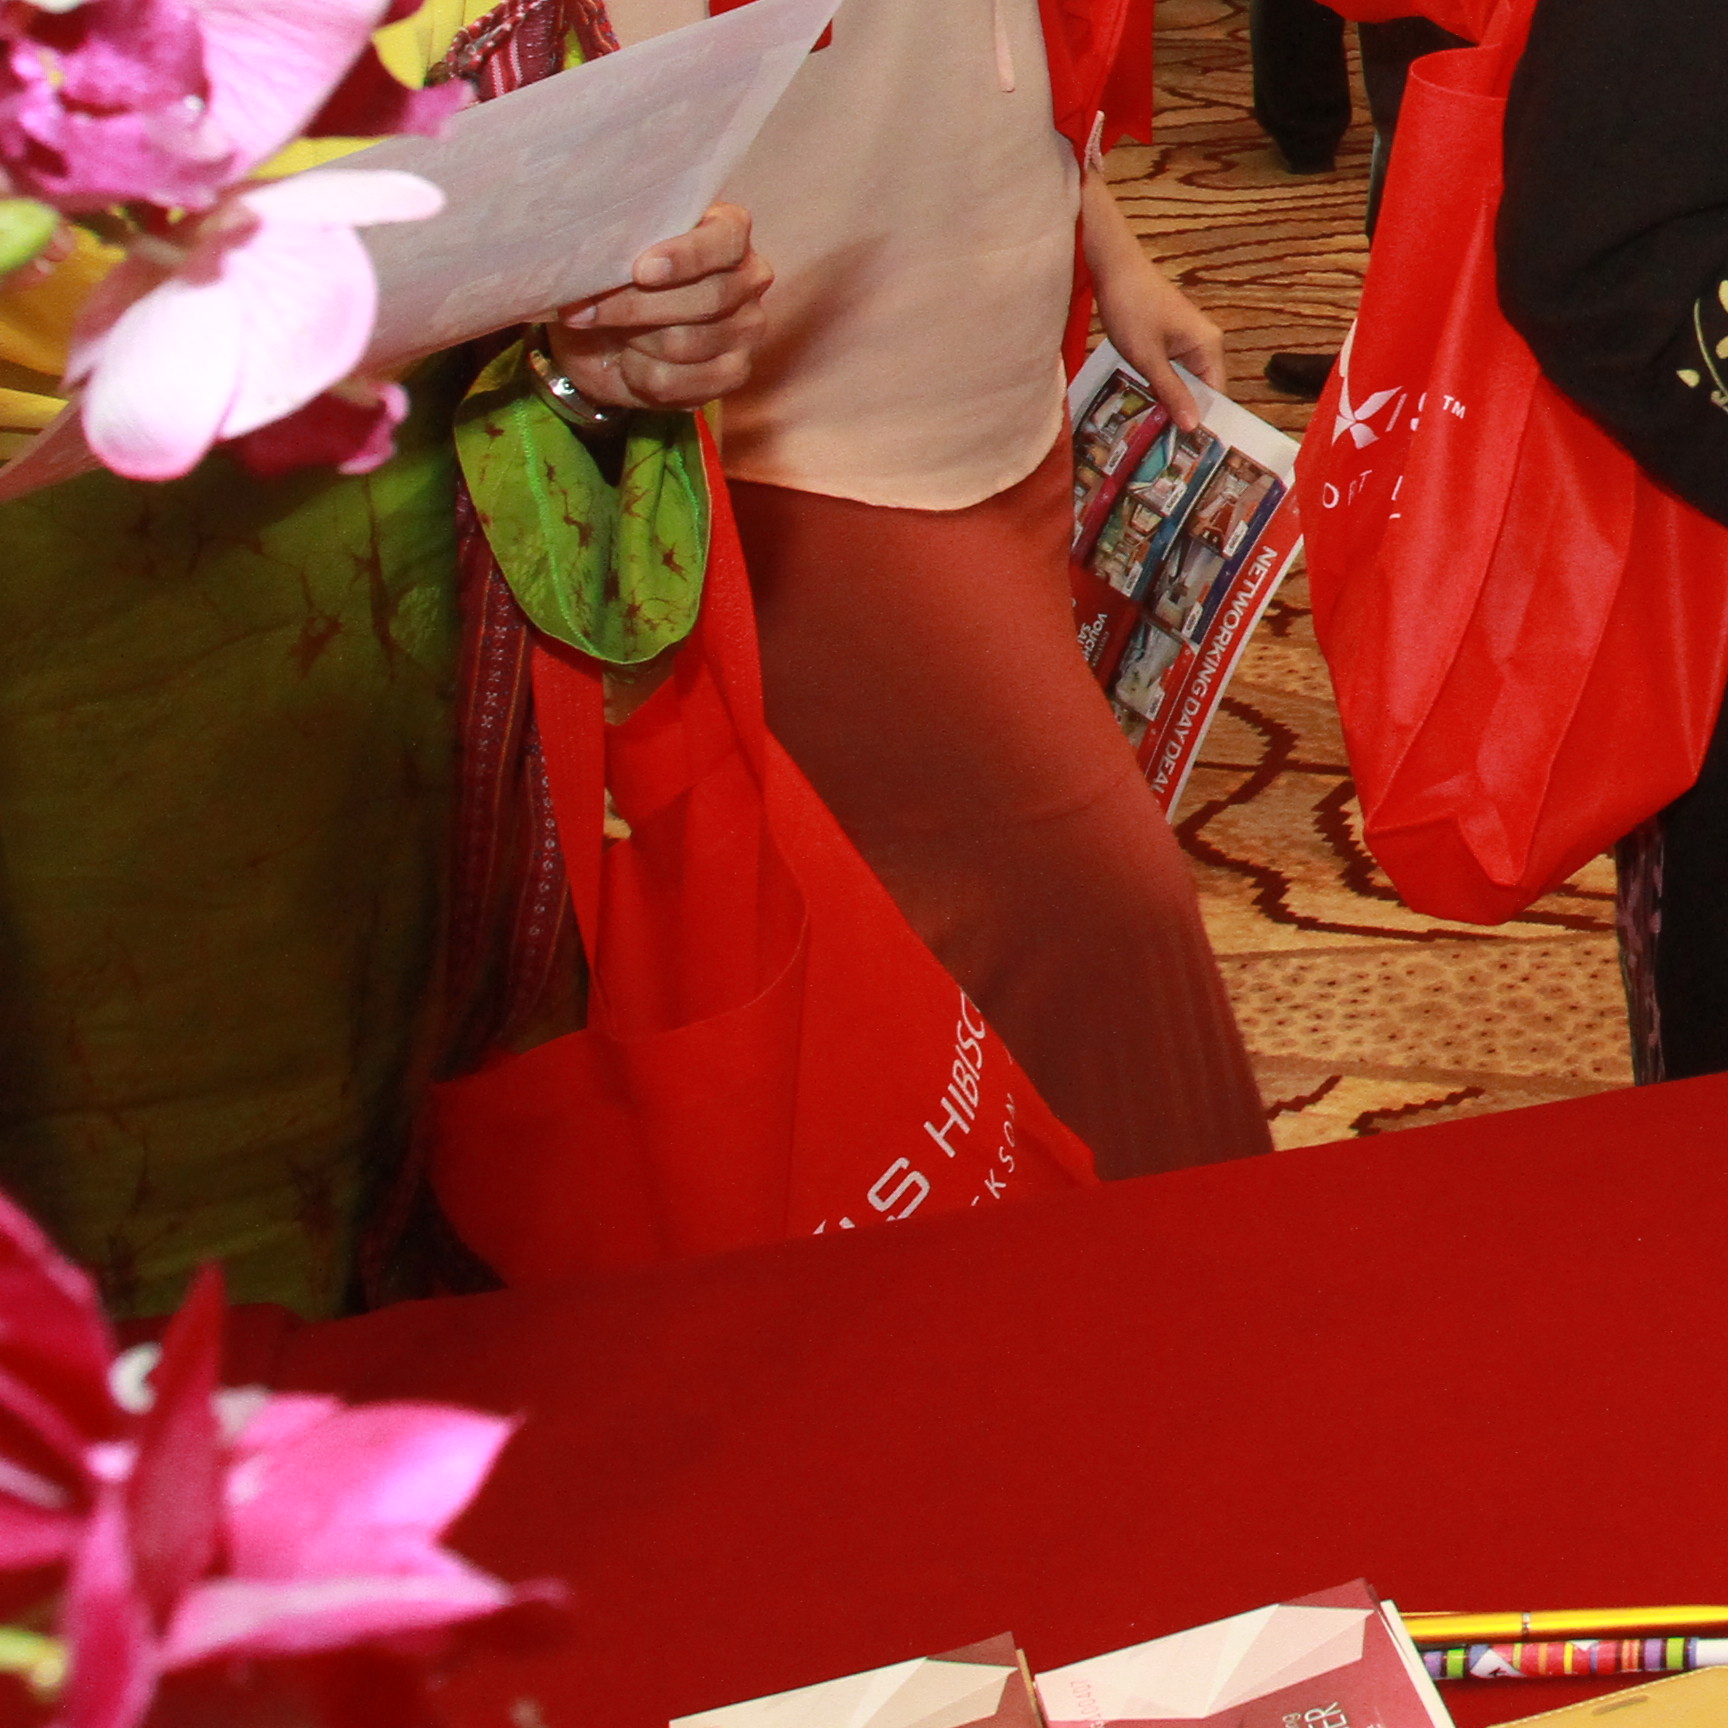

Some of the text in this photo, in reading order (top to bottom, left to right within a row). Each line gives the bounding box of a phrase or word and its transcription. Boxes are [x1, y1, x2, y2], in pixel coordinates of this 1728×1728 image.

[1188, 545, 1278, 698] NETWORKING
[1171, 695, 1201, 741] DAY
[924, 991, 986, 1158] HIBISC
